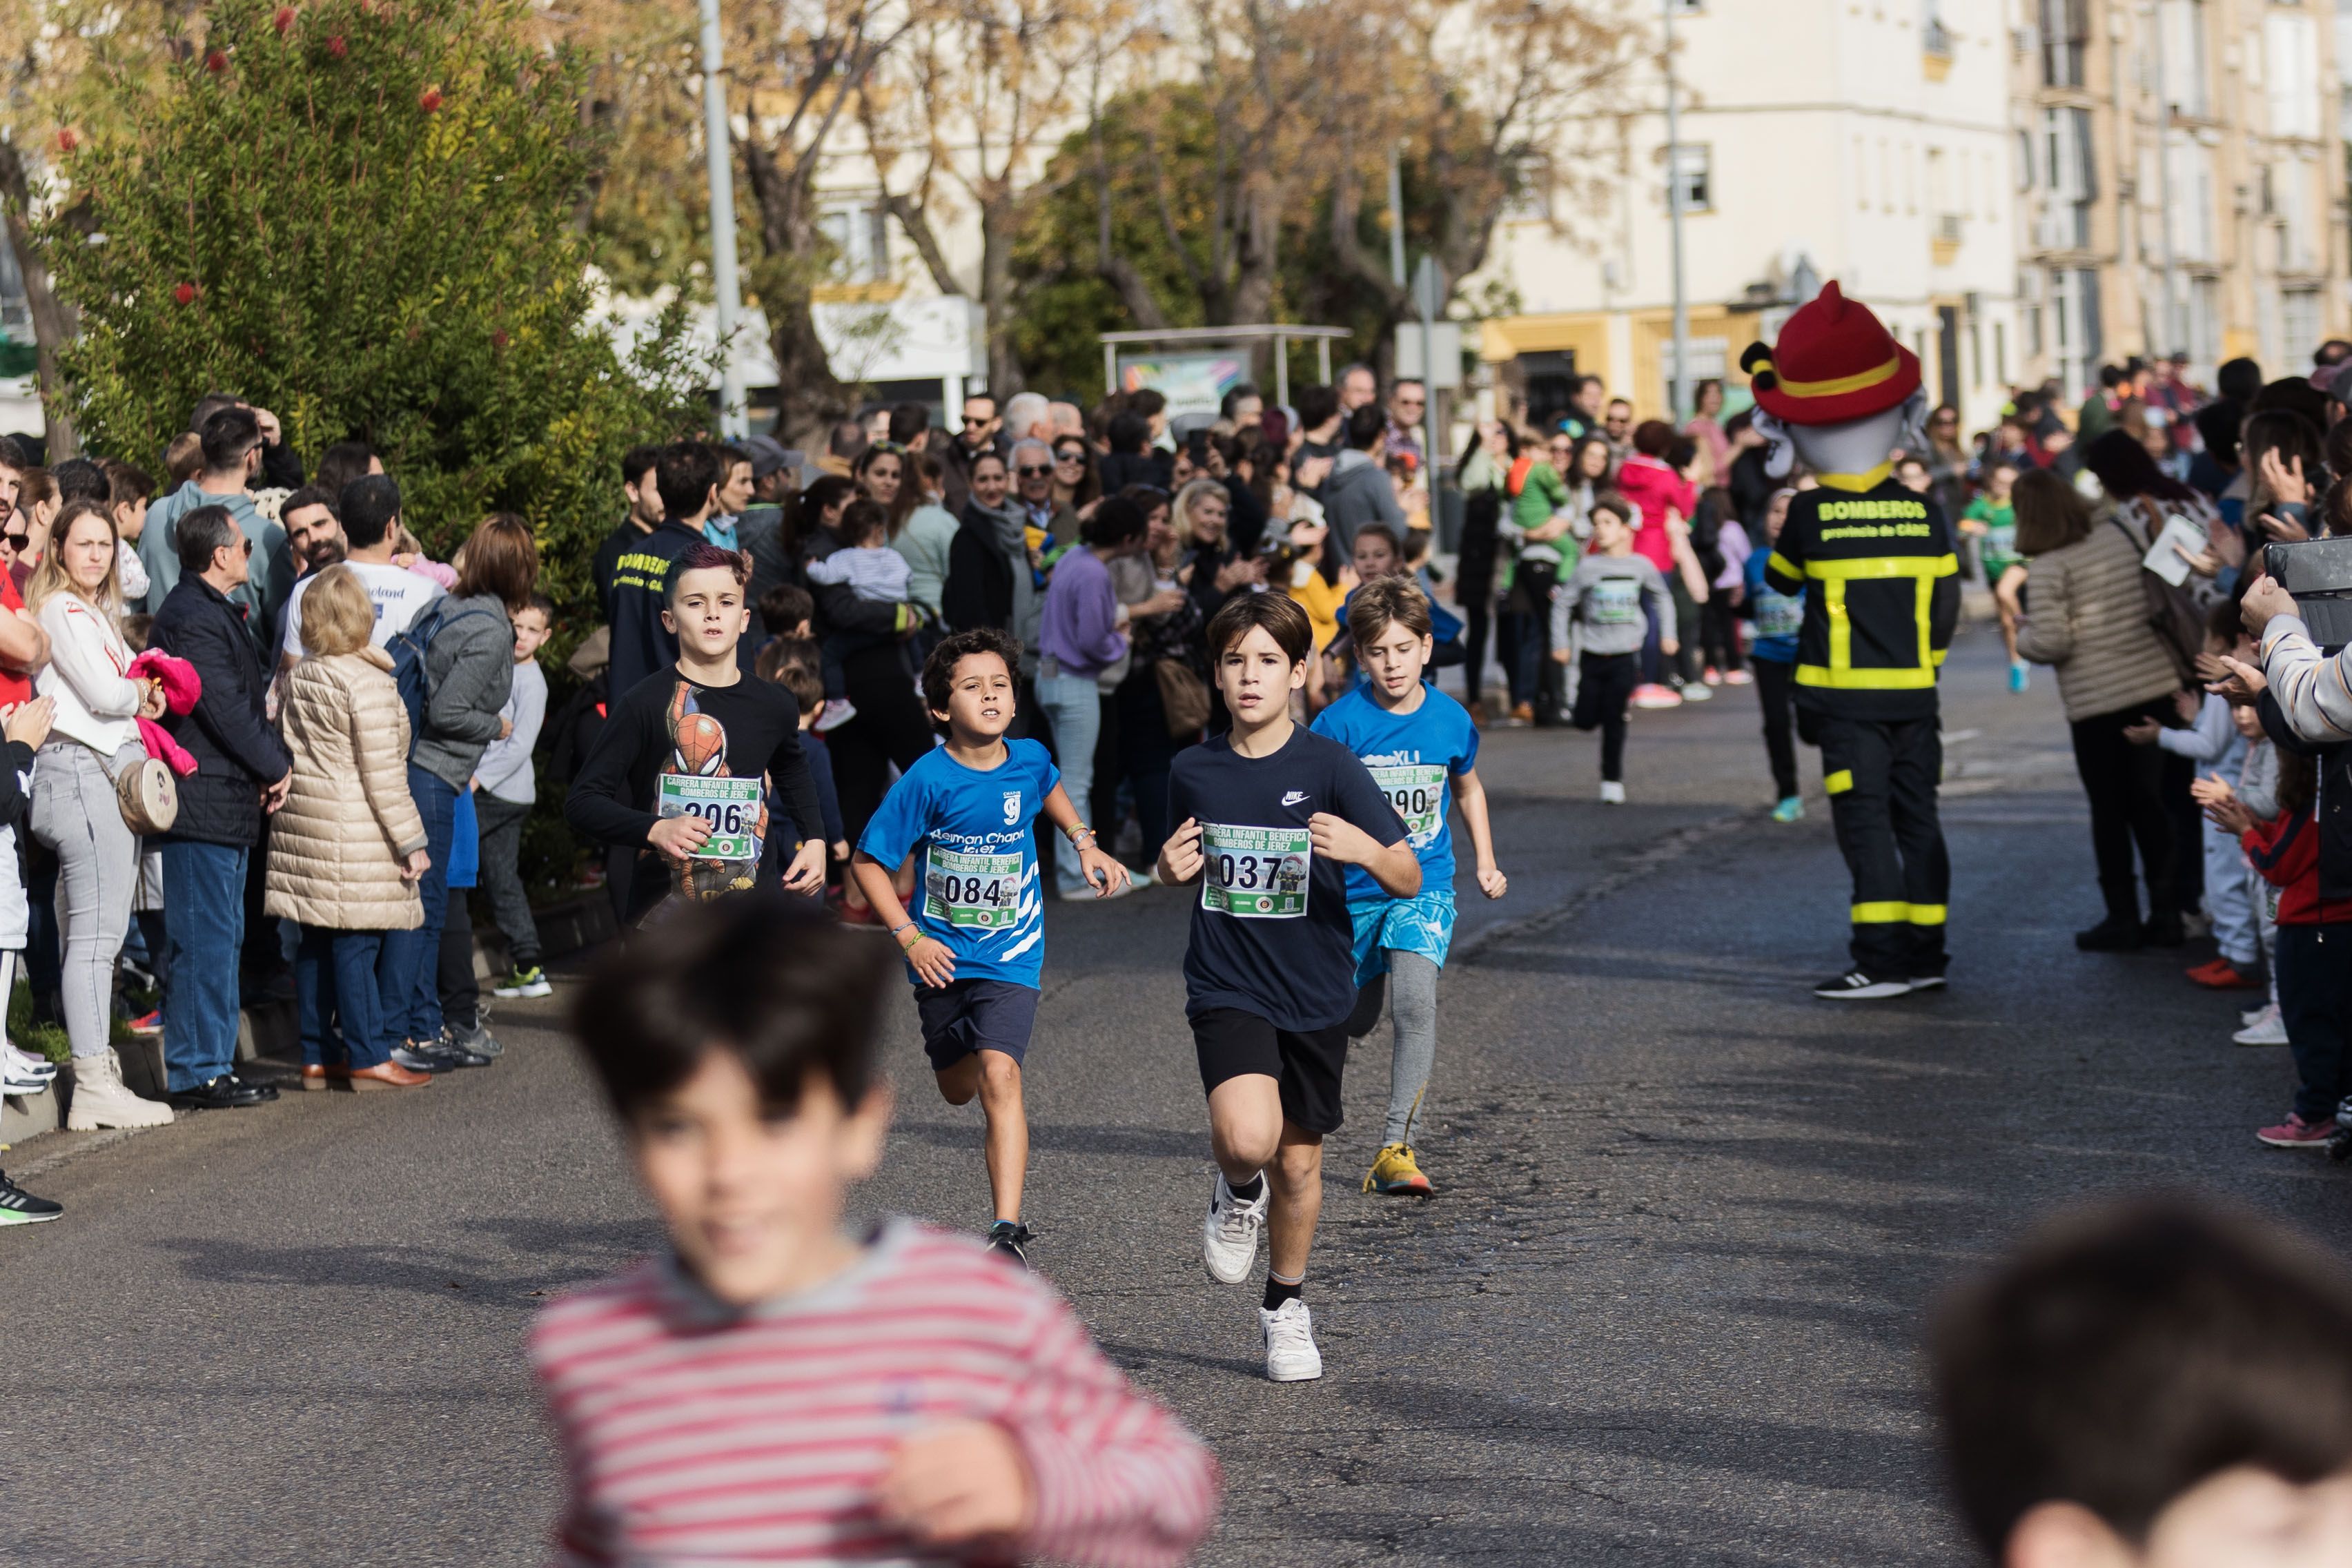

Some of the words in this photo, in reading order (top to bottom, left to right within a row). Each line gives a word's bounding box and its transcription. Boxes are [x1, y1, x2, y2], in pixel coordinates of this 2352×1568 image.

[1818, 500, 1927, 521] BOMBEROS
[667, 776, 699, 788] CARRERA
[700, 780, 730, 790] INFANTIL
[680, 787, 718, 798] BOMBEROS
[720, 790, 729, 798] DE
[729, 790, 749, 799] JEREZ
[1286, 791, 1304, 801] NIKE
[1204, 825, 1231, 839] CARRERA
[1233, 829, 1267, 841] INFANTIL
[1269, 831, 1306, 842] BENEFICA
[1214, 837, 1253, 850] BOMBEROS
[1255, 841, 1266, 850] DE
[1266, 841, 1291, 852] JEREZ
[932, 847, 959, 863] CARRERA
[960, 856, 990, 865] INFANTIL
[942, 860, 978, 873] BOMBEROS
[989, 865, 1010, 874] JEREZ
[1219, 854, 1282, 890] 037
[945, 875, 1001, 906] 084
